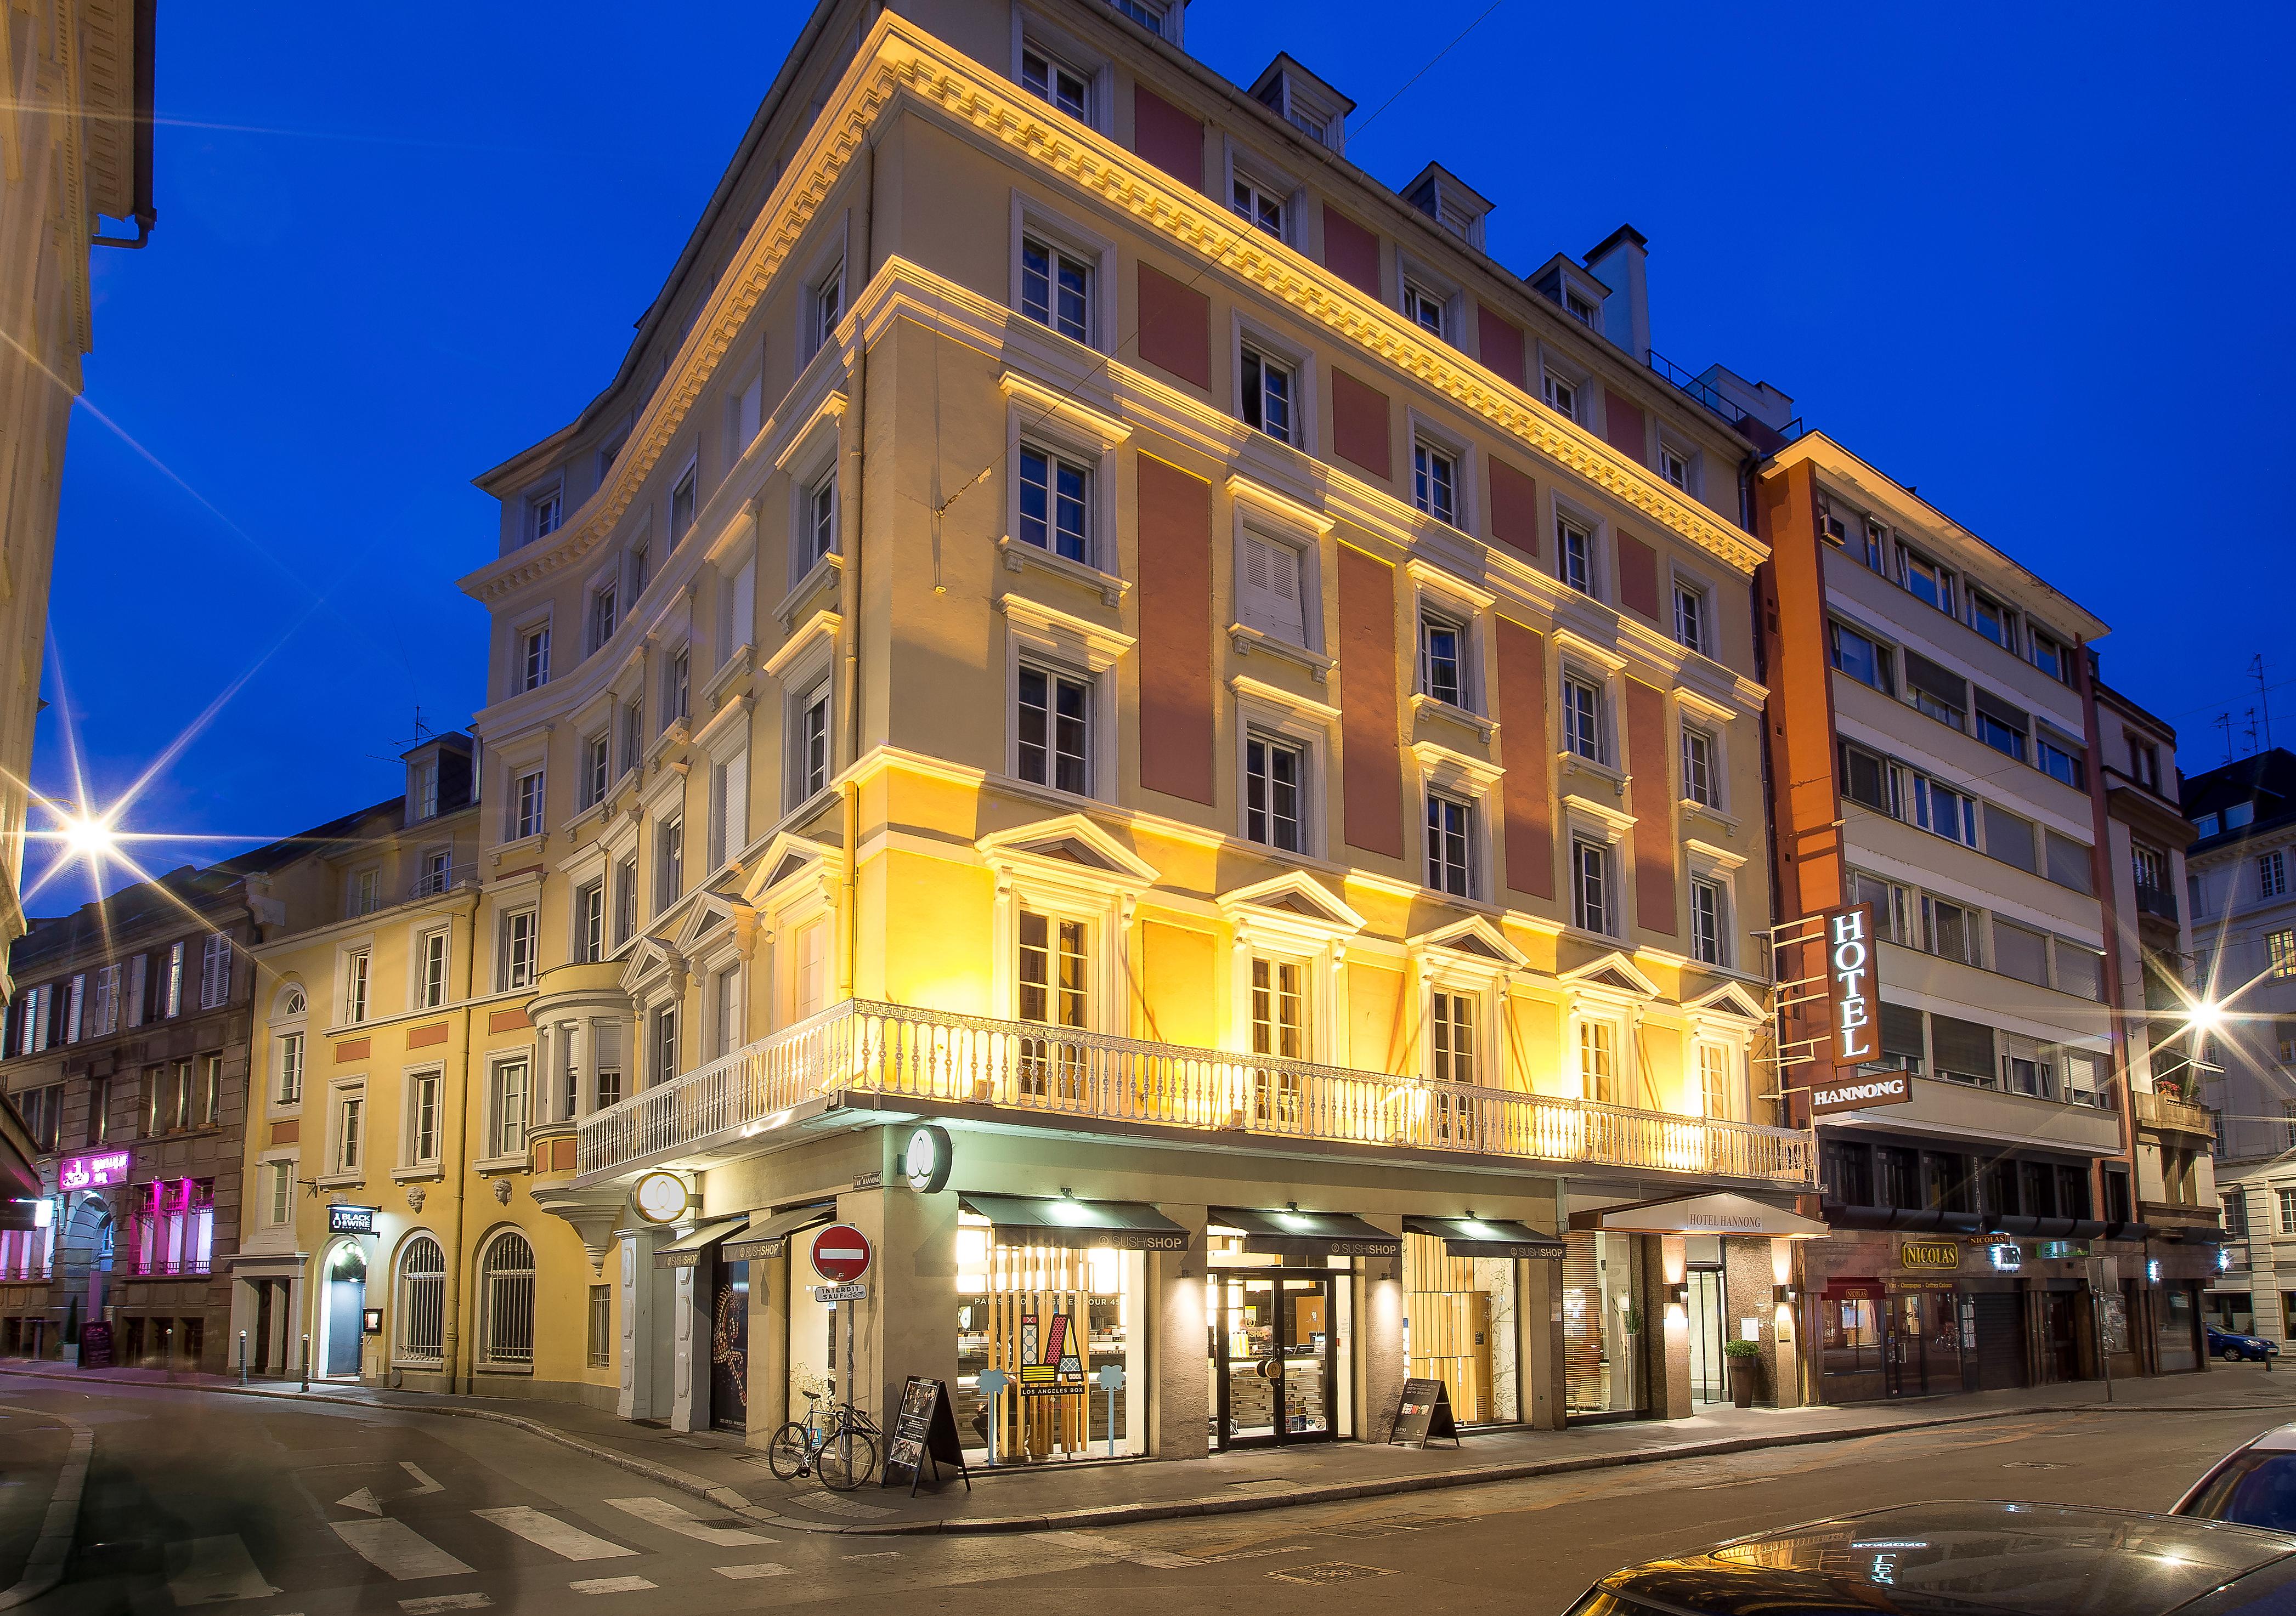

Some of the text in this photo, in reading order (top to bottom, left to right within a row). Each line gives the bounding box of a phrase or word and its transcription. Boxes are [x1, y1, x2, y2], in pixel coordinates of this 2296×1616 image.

[1832, 910, 1869, 1058] HOTEL
[1813, 1079, 1904, 1105] HANNONG
[1973, 1157, 1982, 1232] RESTAURAT
[342, 1213, 371, 1221] BLACK
[1690, 1214, 1761, 1228] HOTEL HANNONG
[1907, 1247, 1955, 1263] NICOLAS
[822, 1286, 859, 1294] INTERDIT
